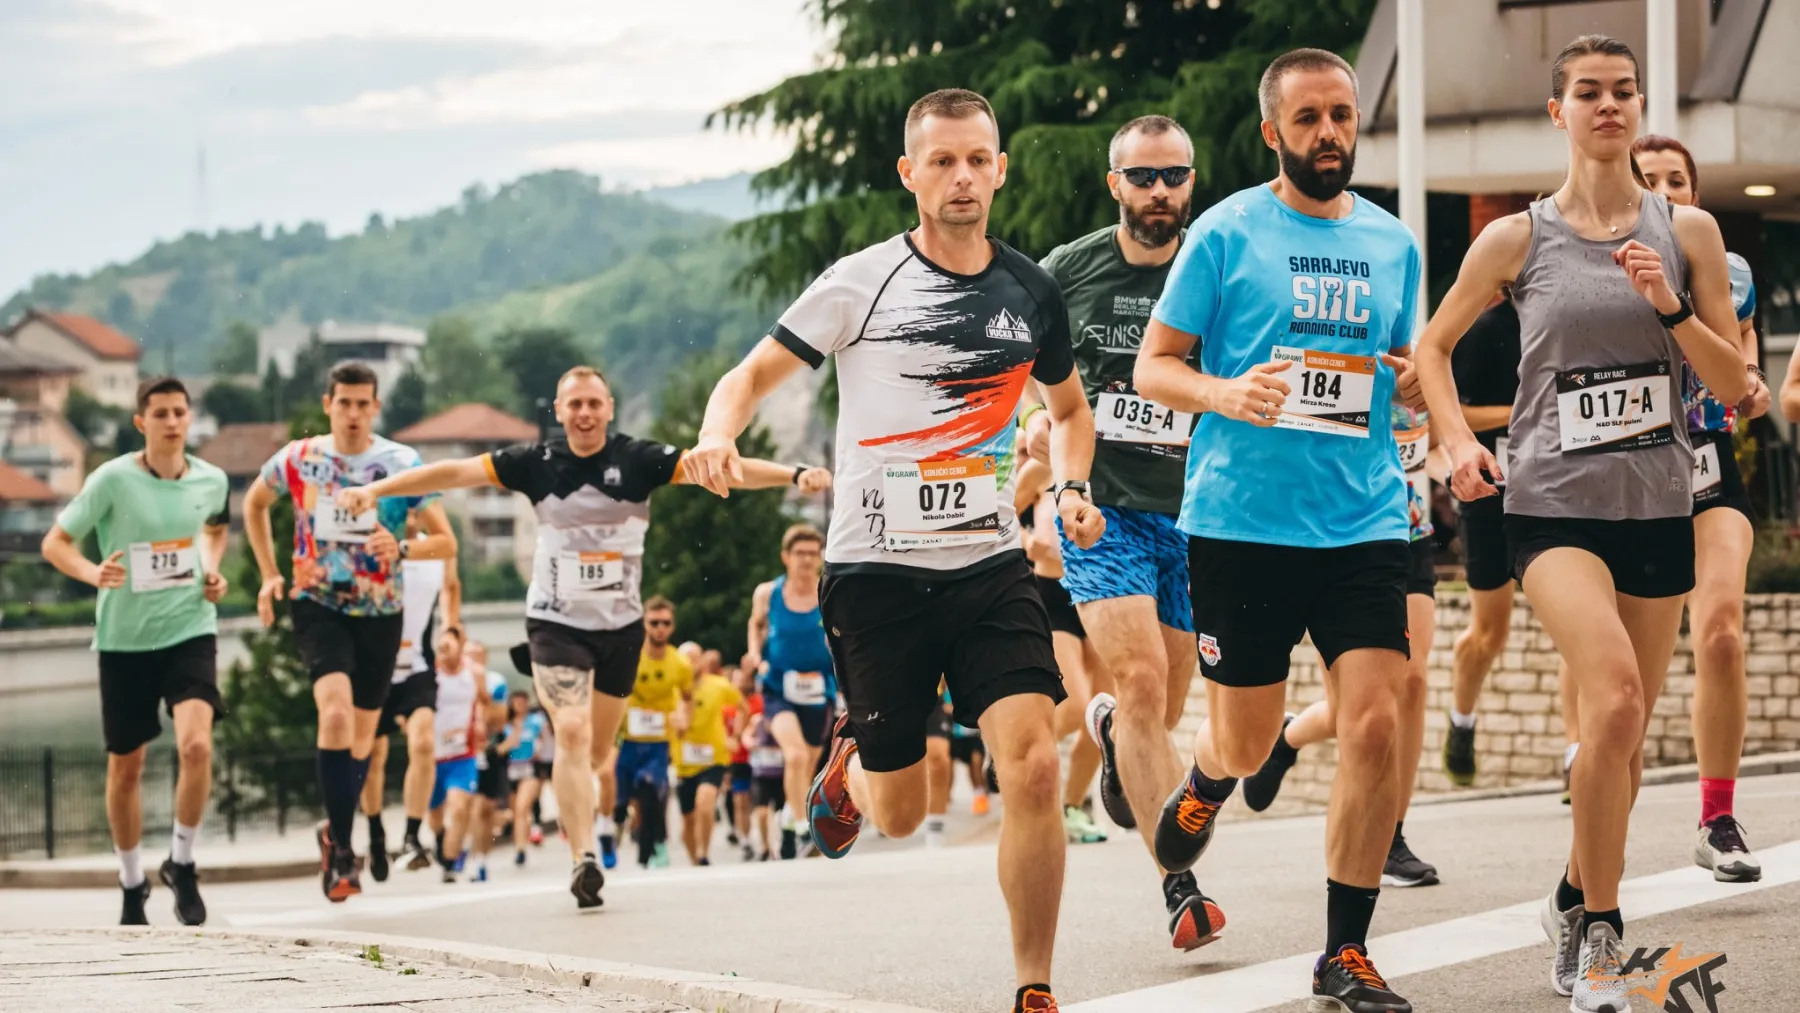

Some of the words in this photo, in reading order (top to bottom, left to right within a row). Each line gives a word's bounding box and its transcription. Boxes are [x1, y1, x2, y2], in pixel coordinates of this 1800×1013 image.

[1289, 256, 1370, 278] SARAJEVO
[1114, 295, 1138, 305] BMW
[1112, 309, 1149, 317] MARATHON
[1083, 324, 1146, 348] FINIS
[1289, 321, 1336, 337] RUNNING
[1338, 325, 1368, 340] CLUB
[1593, 371, 1611, 381] RELAY
[1612, 369, 1627, 379] RACE
[1301, 370, 1342, 400] 184
[1300, 398, 1317, 407] Mirza
[1317, 400, 1336, 409] Kreso
[1579, 386, 1653, 420] 017-A
[1113, 397, 1174, 430] 035-A
[1399, 442, 1416, 461] 23
[895, 470, 919, 479] GRAWE
[919, 481, 967, 512] 072
[922, 513, 945, 521] Nikola
[151, 552, 179, 570] 270
[579, 564, 604, 579] 185
